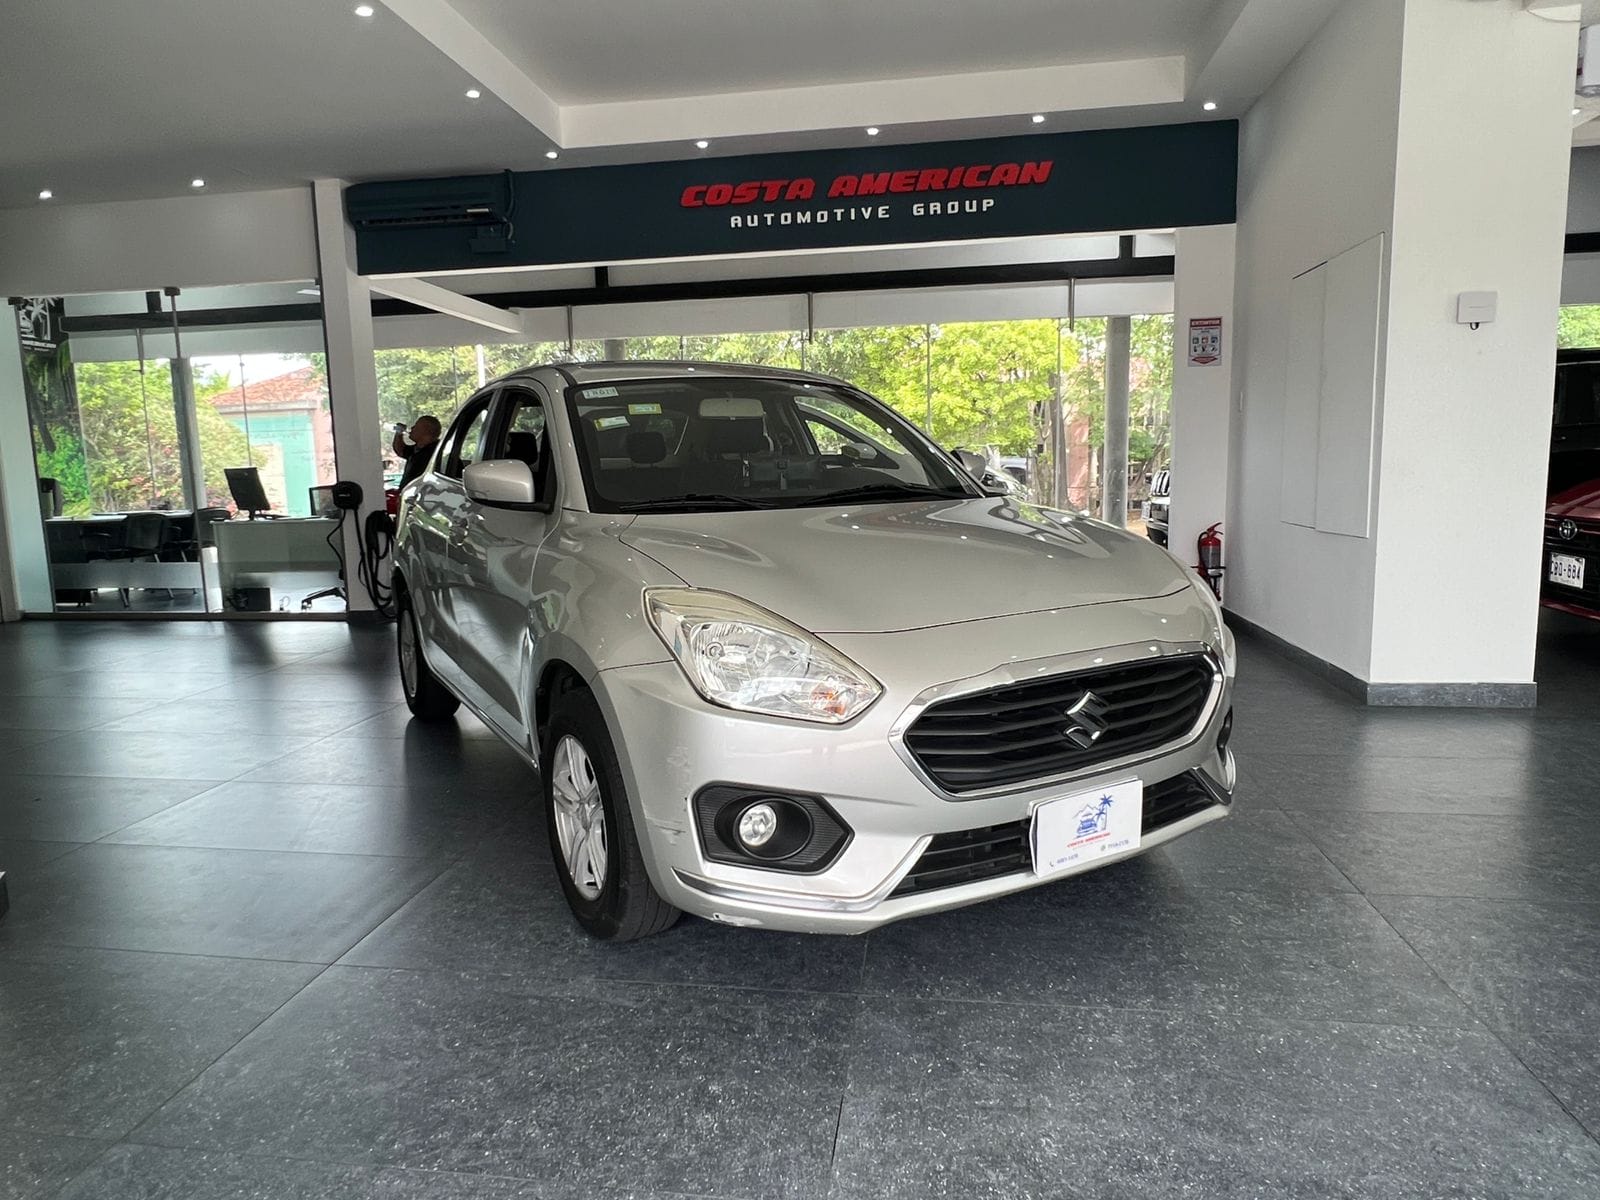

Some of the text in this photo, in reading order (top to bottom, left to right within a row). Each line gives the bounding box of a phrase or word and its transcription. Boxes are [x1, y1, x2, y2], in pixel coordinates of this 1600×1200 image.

[680, 160, 1053, 208] COSTA AMERICAN
[730, 199, 995, 228] AUTOMOTIVE GROUP
